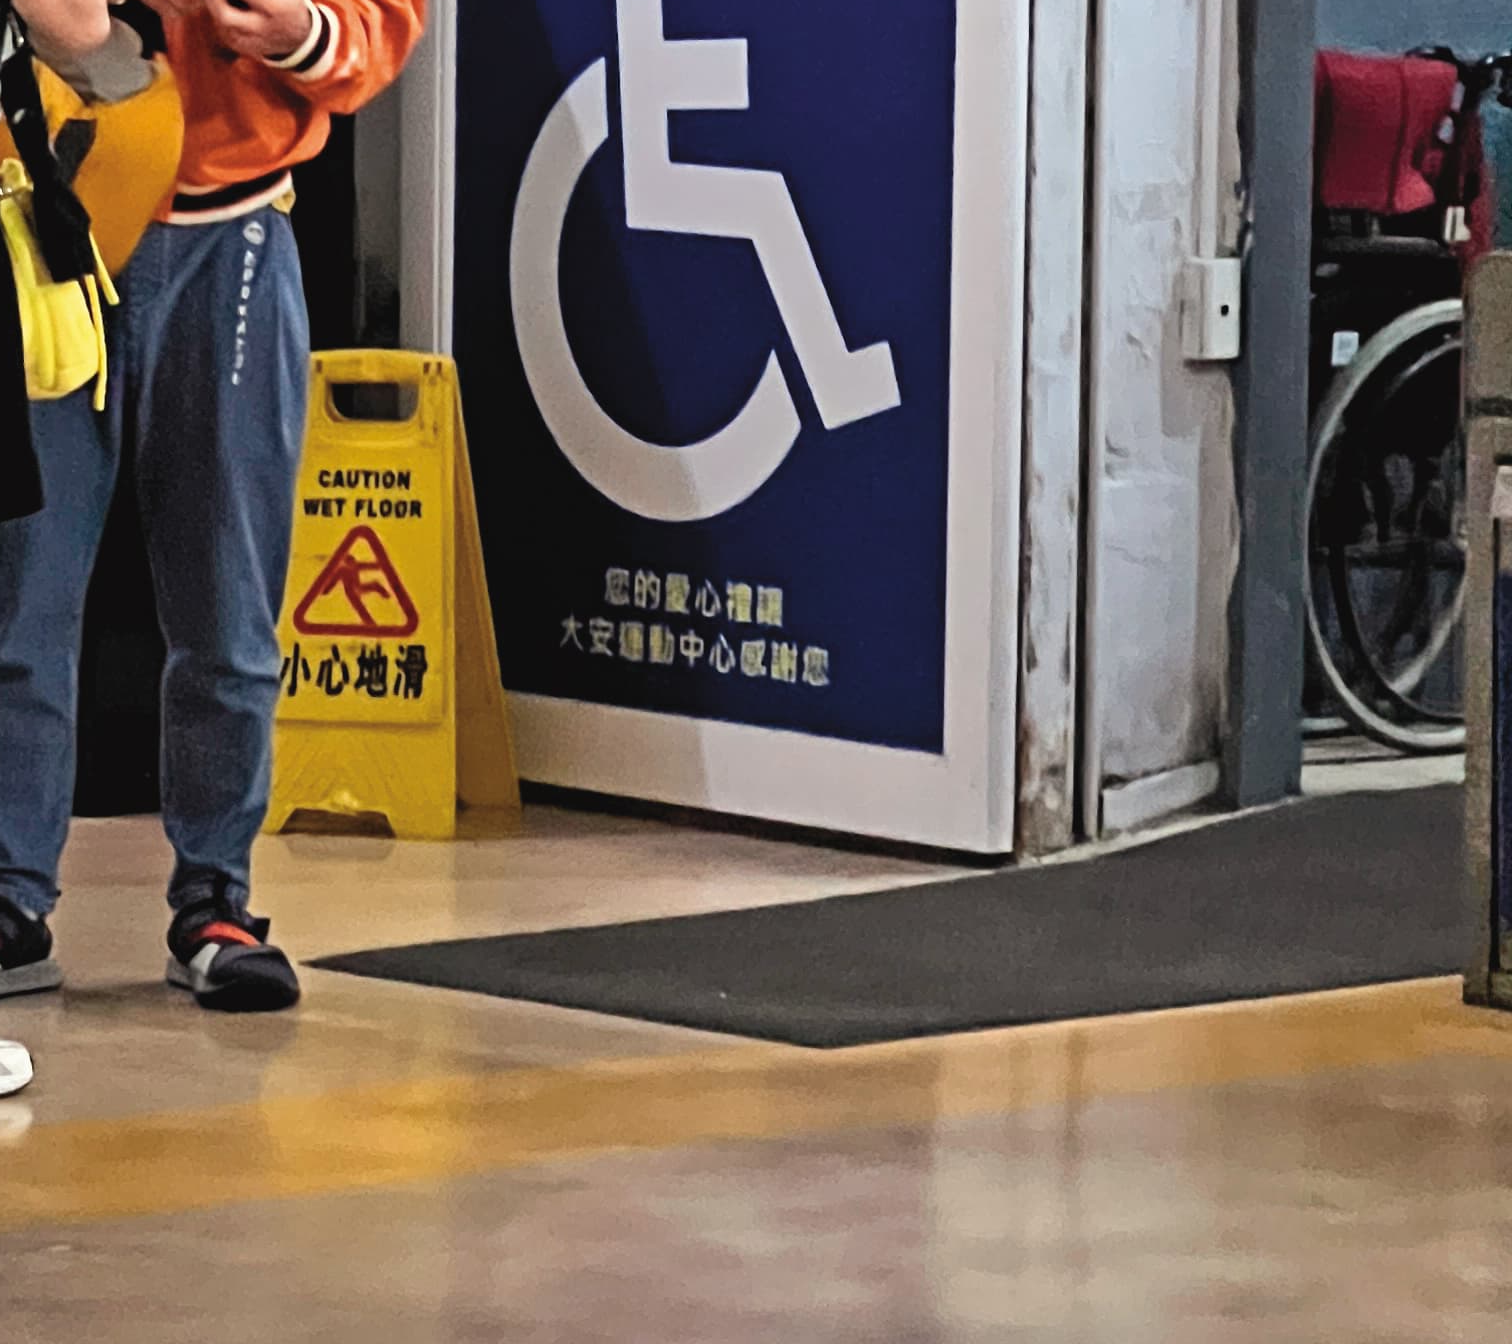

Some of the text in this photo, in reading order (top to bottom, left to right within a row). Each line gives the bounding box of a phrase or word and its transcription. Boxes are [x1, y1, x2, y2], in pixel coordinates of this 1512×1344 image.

[318, 469, 412, 490] CAUTION
[303, 498, 422, 519] WET FLOOR
[279, 642, 428, 700] 小心地滑
